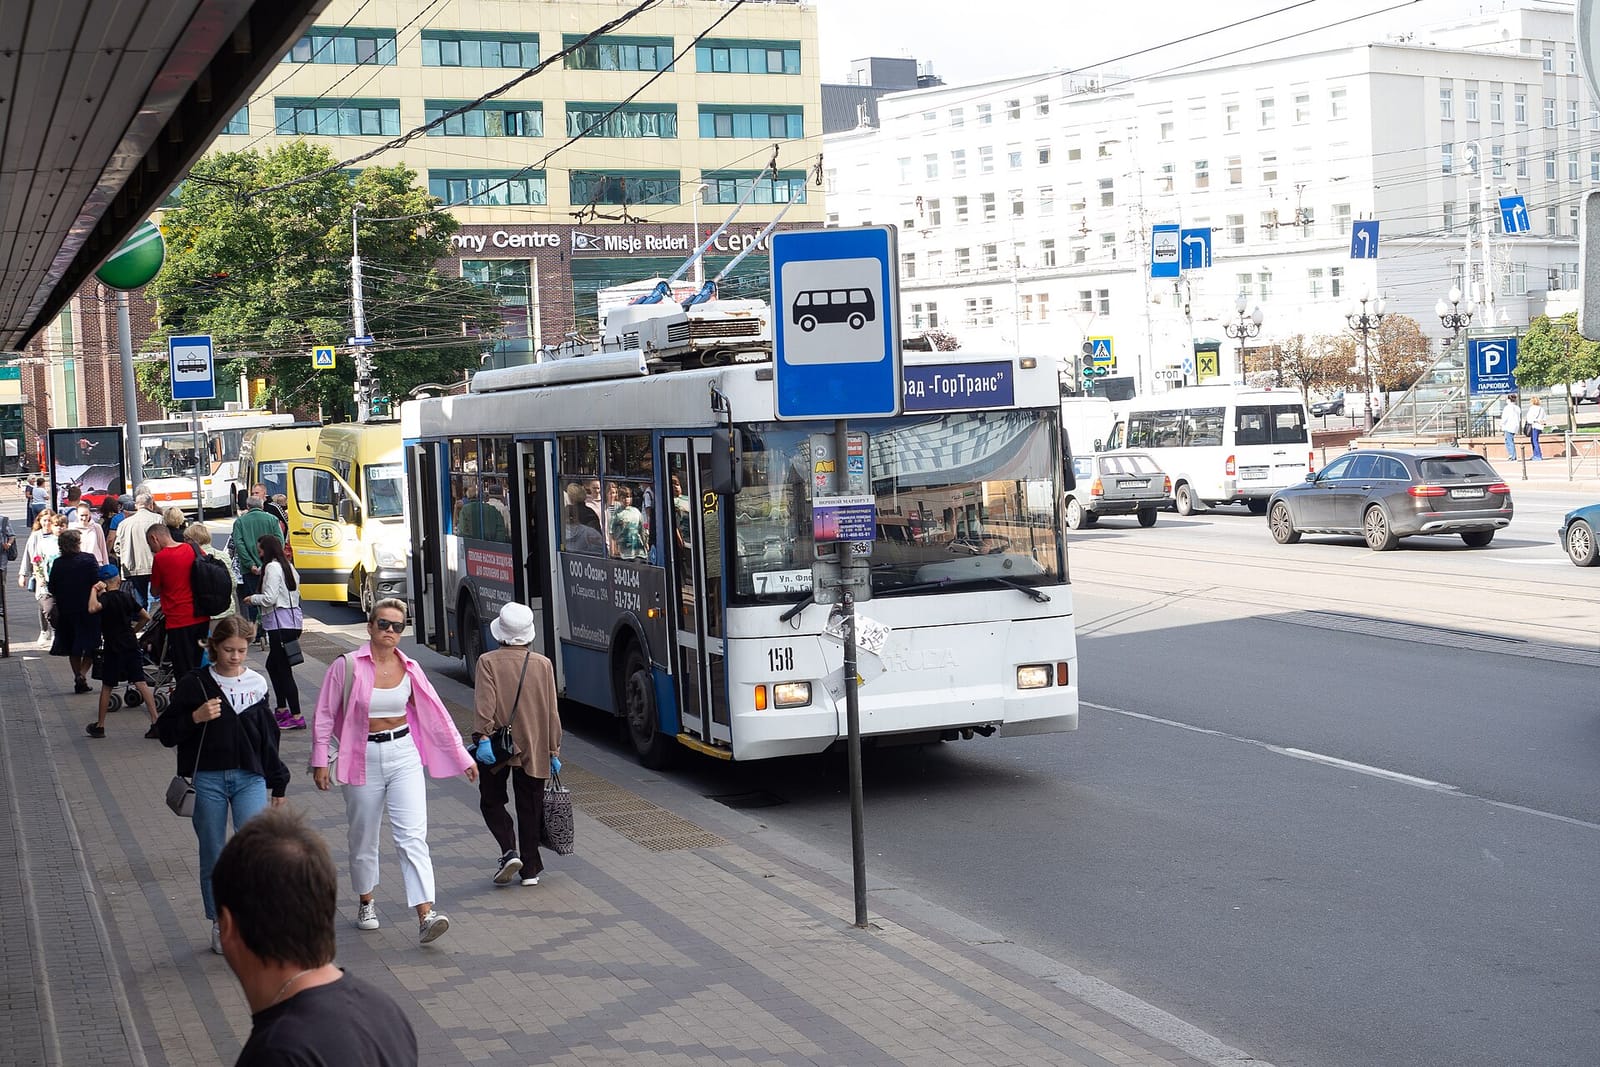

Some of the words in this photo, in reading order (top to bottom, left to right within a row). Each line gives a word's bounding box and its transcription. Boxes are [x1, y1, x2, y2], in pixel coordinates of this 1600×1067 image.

[492, 231, 560, 248] Centre
[604, 234, 642, 254] Misje
[645, 234, 690, 251] Rederi
[1154, 370, 1179, 380] СТОП
[1478, 382, 1510, 390] ПАРКОВКА
[569, 560, 583, 578] ООО
[614, 567, 640, 589] 58-01-64
[756, 576, 768, 594] 7
[615, 590, 641, 612] 51-73-74
[768, 646, 794, 672] 158
